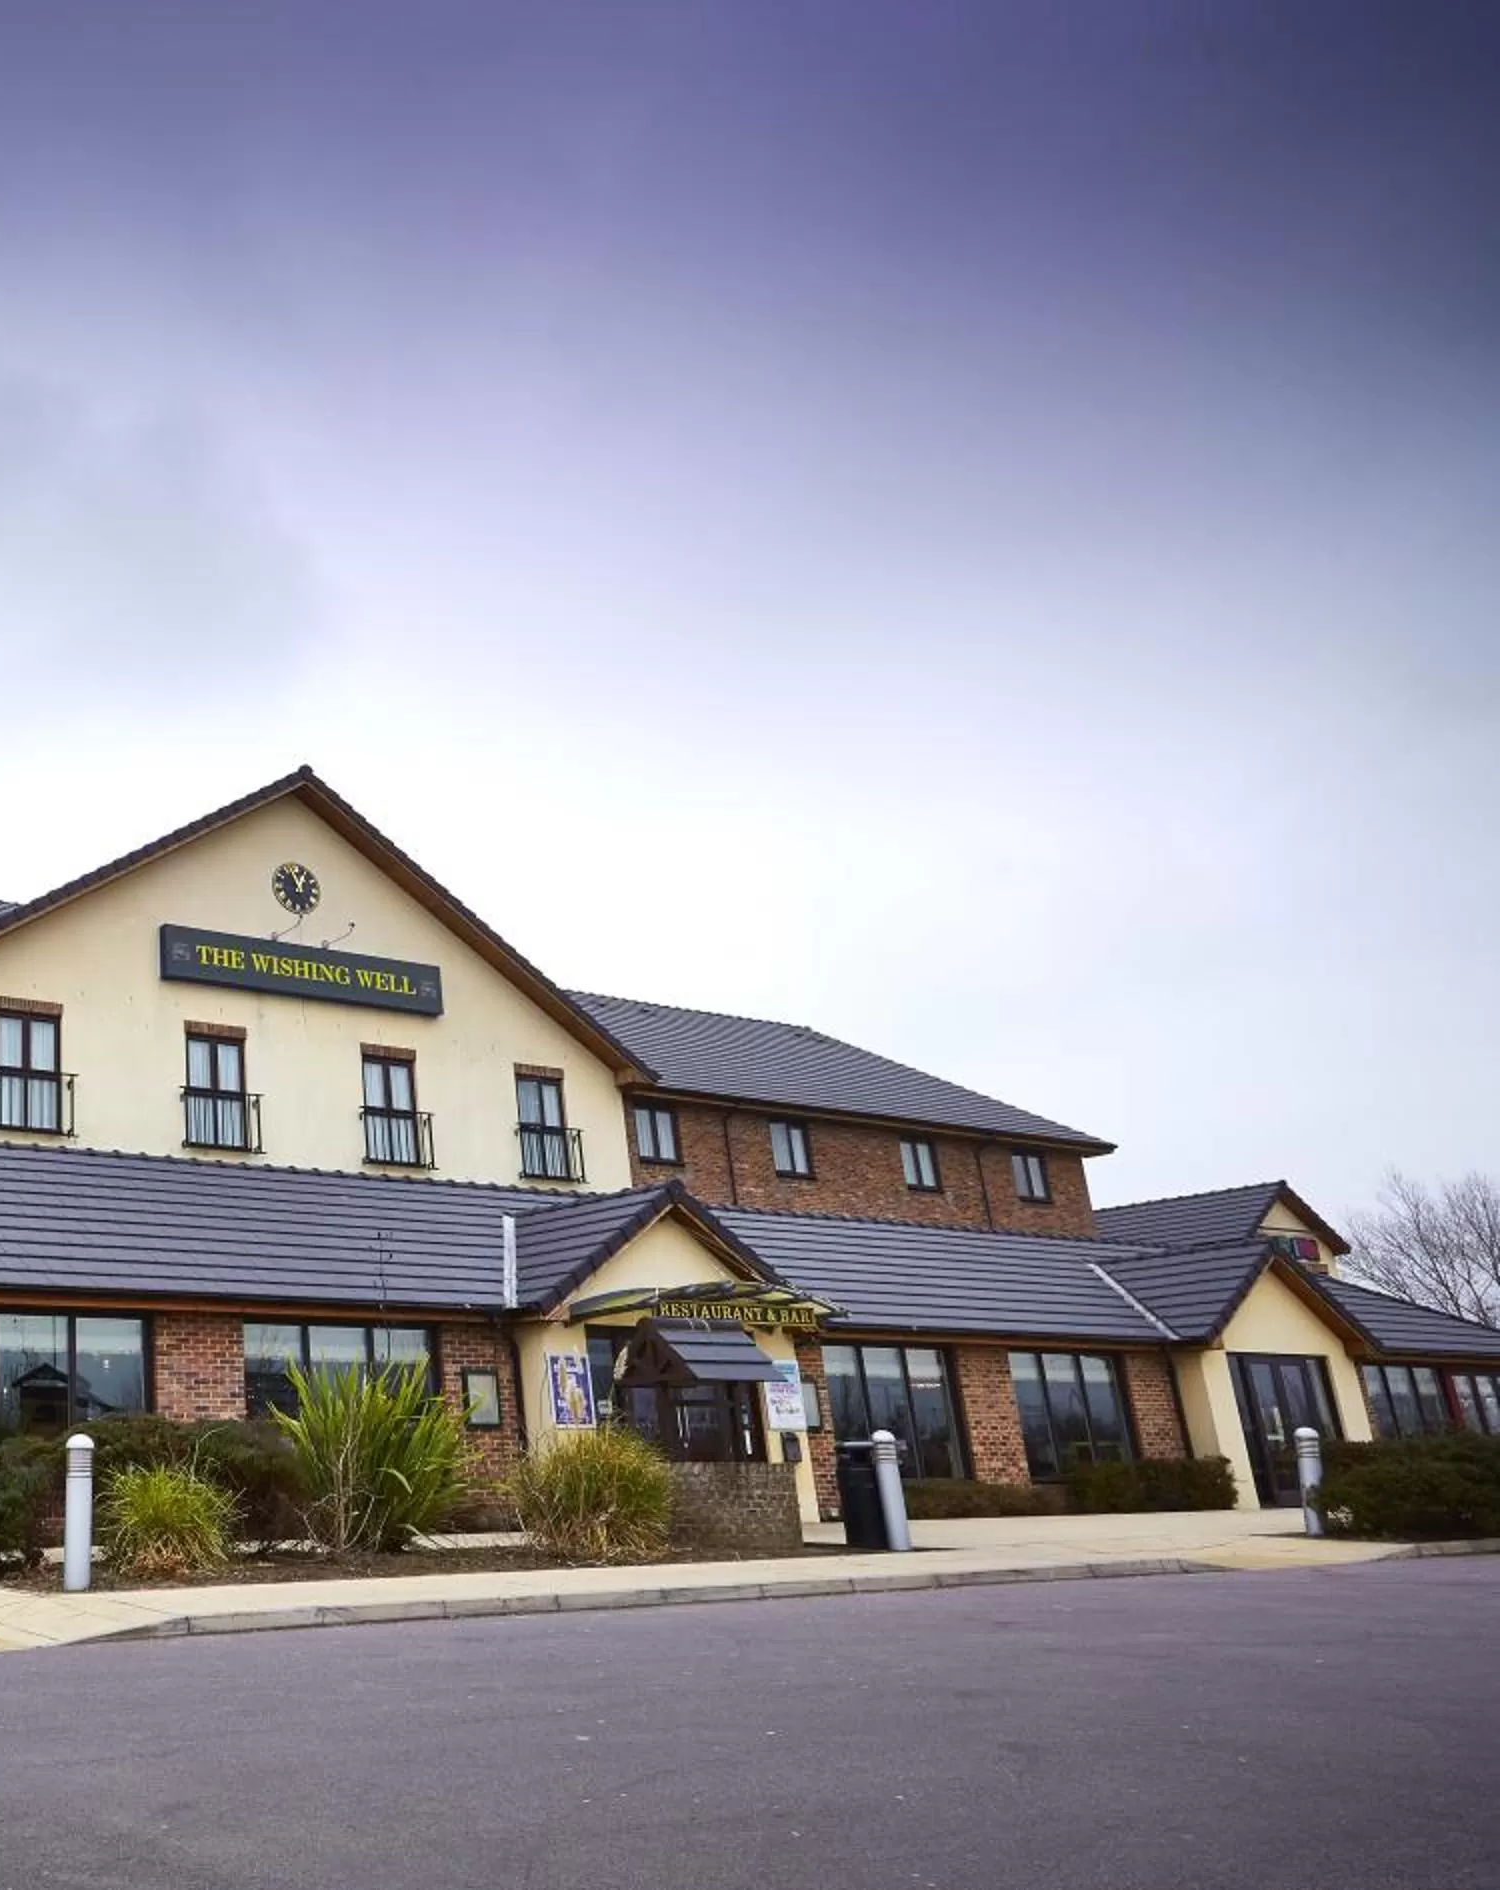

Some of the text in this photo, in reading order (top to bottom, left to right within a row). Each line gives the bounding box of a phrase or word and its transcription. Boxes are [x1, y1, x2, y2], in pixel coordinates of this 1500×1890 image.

[196, 945, 417, 994] THE WISHING WELL
[659, 1302, 811, 1323] RESTAURANT & BAR
